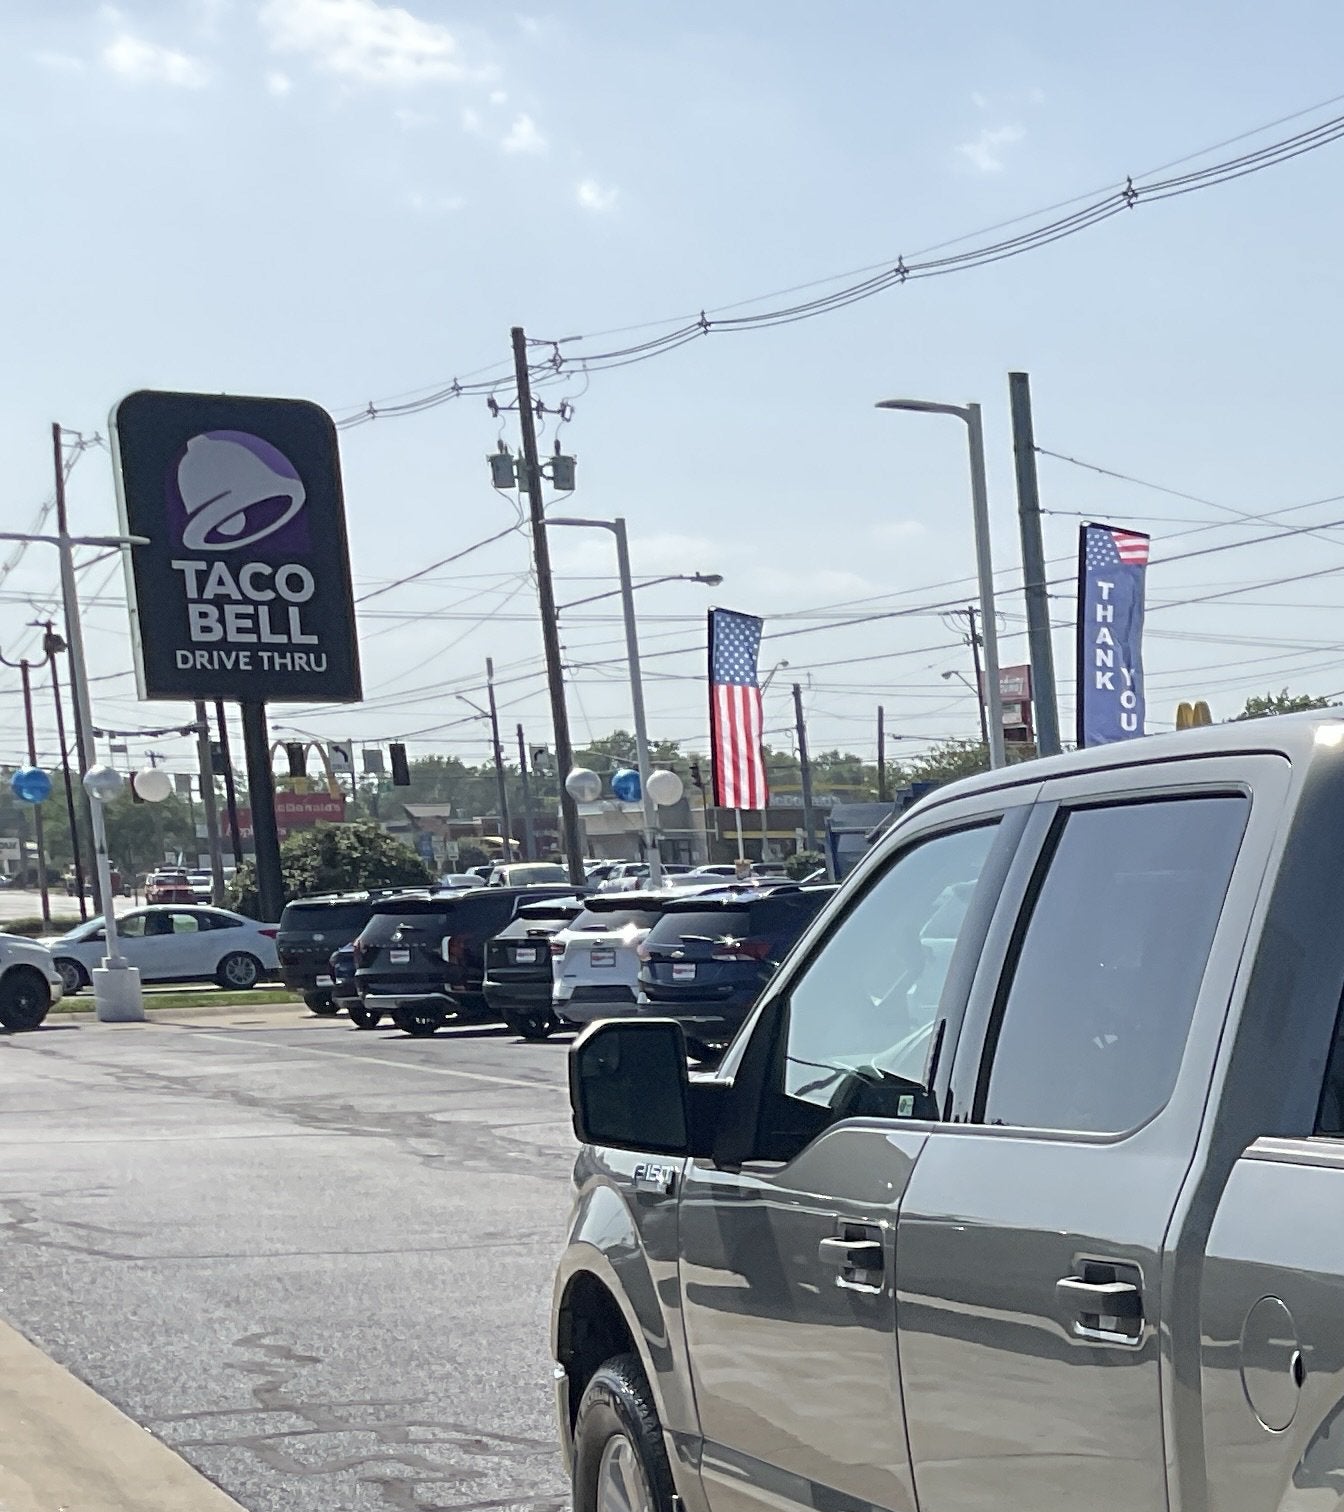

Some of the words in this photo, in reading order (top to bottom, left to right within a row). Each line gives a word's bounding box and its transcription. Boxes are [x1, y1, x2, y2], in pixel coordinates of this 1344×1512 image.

[171, 559, 316, 603] TACO
[187, 603, 319, 645] BELL
[1095, 580, 1115, 690] THANK
[175, 650, 252, 671] DRIVE
[258, 651, 328, 673] THRU
[1120, 666, 1138, 732] YOU
[276, 802, 341, 813] cDonald's
